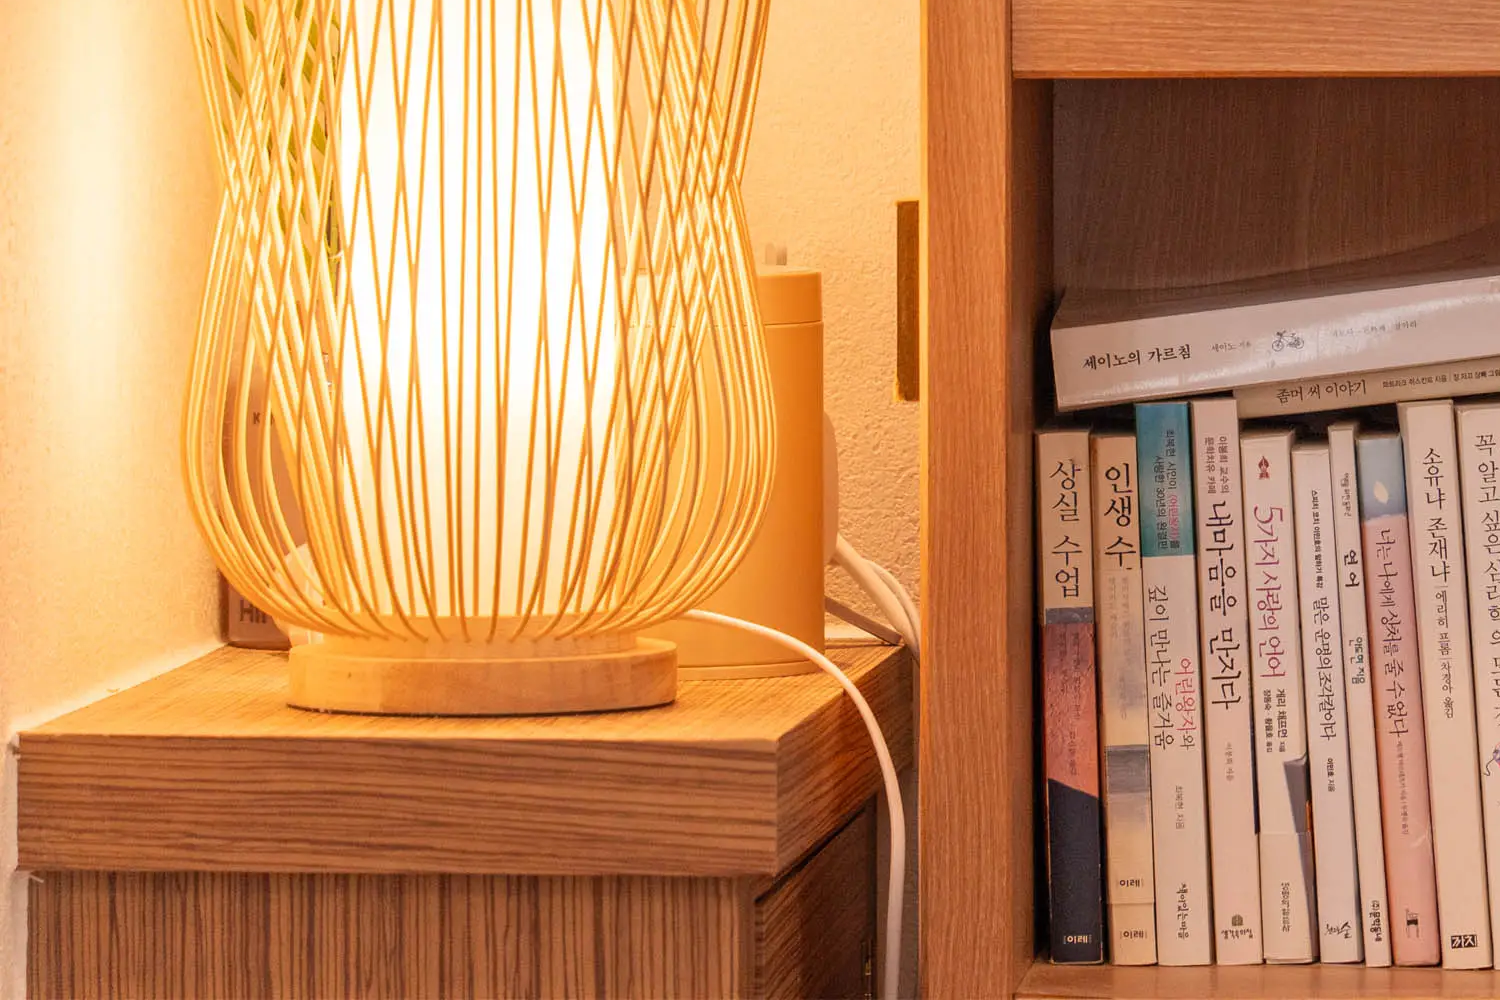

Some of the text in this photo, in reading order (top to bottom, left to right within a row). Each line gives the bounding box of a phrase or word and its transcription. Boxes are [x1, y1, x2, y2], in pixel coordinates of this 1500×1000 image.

[1083, 345, 1191, 370] 세이노의 가르침
[1307, 383, 1321, 397] 씨
[1325, 379, 1366, 396] 이야기
[1475, 434, 1496, 456] 꼭
[1050, 459, 1080, 522] 상실
[1423, 447, 1446, 510] 소유냐
[1478, 461, 1500, 503] 알고
[1376, 529, 1395, 558] 너는
[1427, 518, 1450, 583] 존재냐
[1051, 535, 1083, 599] 수업
[1344, 550, 1360, 588] 연어
[1377, 563, 1399, 607] 나에게
[1254, 506, 1285, 678] 5가지 사랑의 언어
[1436, 590, 1448, 629] 에리히
[1381, 609, 1401, 656] 상처를
[1439, 633, 1451, 655] 프롬
[1148, 585, 1174, 750] 깊이 만나는 즐거움
[1209, 627, 1242, 709] 만지다
[1313, 597, 1336, 740] 말은 운명의 조각칼이다
[1349, 637, 1365, 684] 안도현 지음
[1385, 660, 1404, 677] 줄
[1174, 658, 1195, 750] 어린왕자와
[1387, 681, 1404, 698] 수
[1387, 702, 1409, 737] 없다
